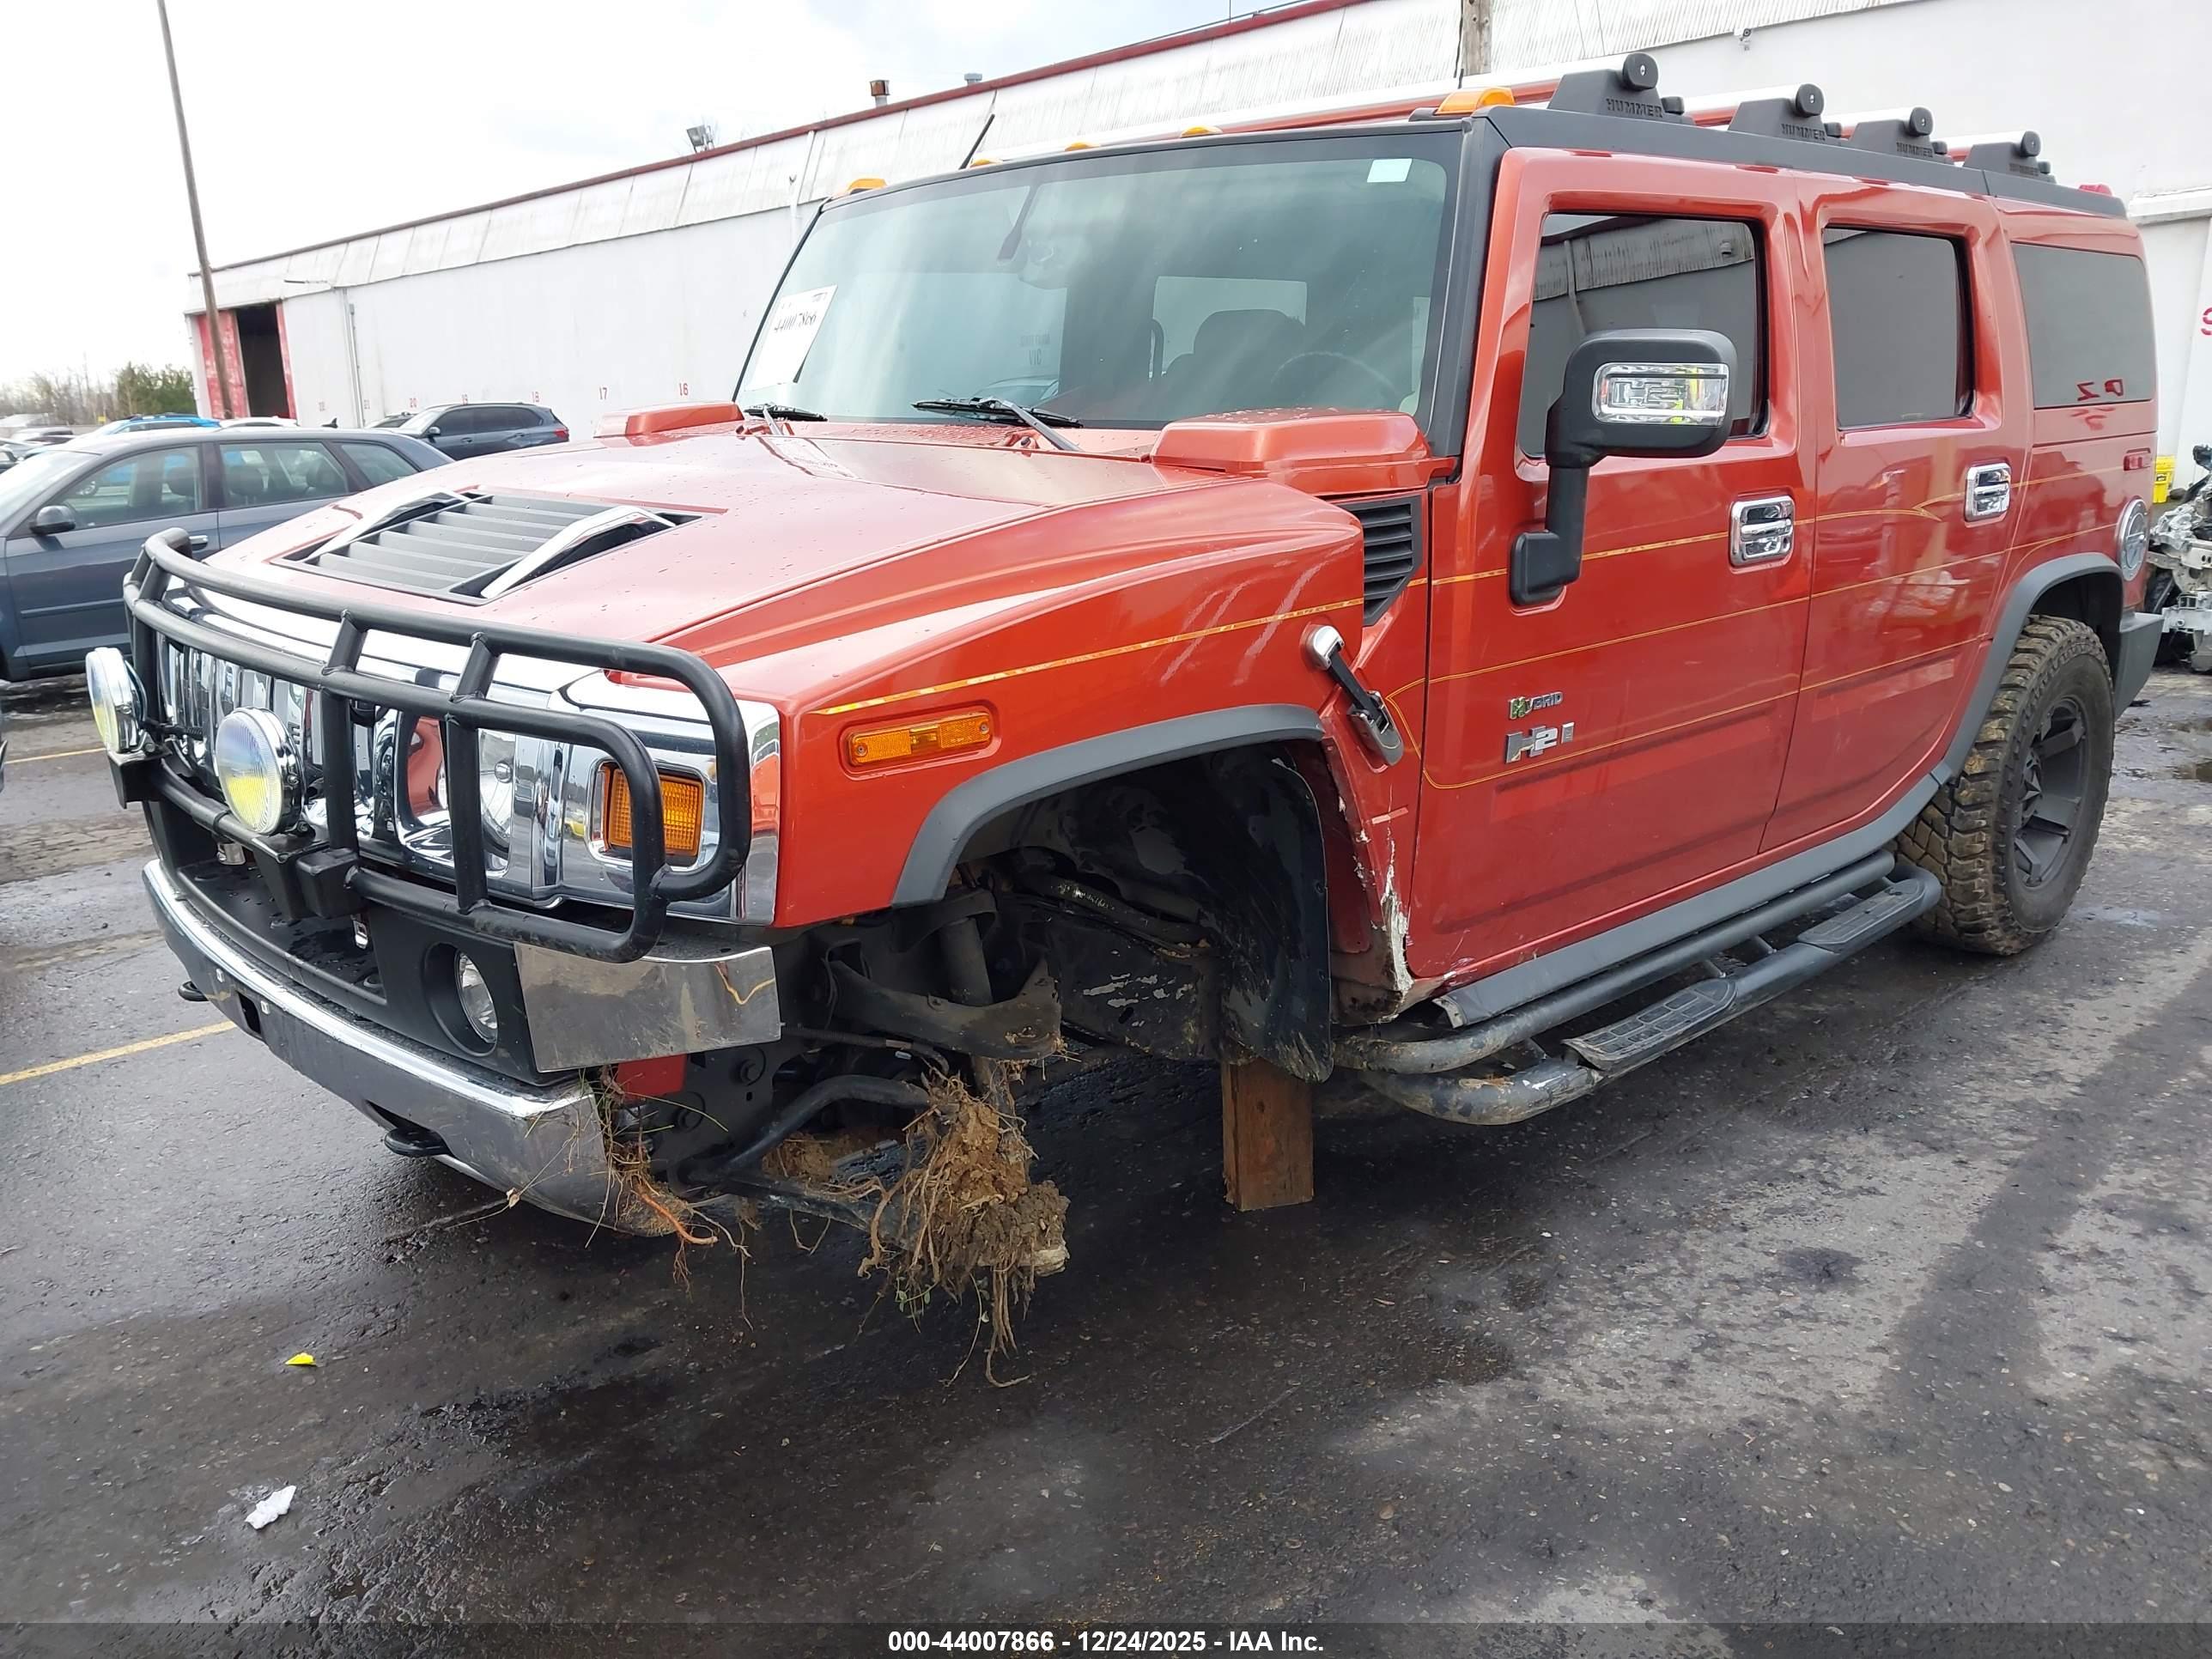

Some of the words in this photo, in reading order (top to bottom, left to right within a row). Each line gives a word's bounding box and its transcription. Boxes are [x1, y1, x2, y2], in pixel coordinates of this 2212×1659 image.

[1606, 97, 1664, 118] HUMMER
[1781, 123, 1826, 142] HUMMER
[1896, 142, 1935, 159] HUMMER
[599, 386, 608, 400] 17
[678, 383, 689, 396] 16
[1505, 725, 1559, 764] H2
